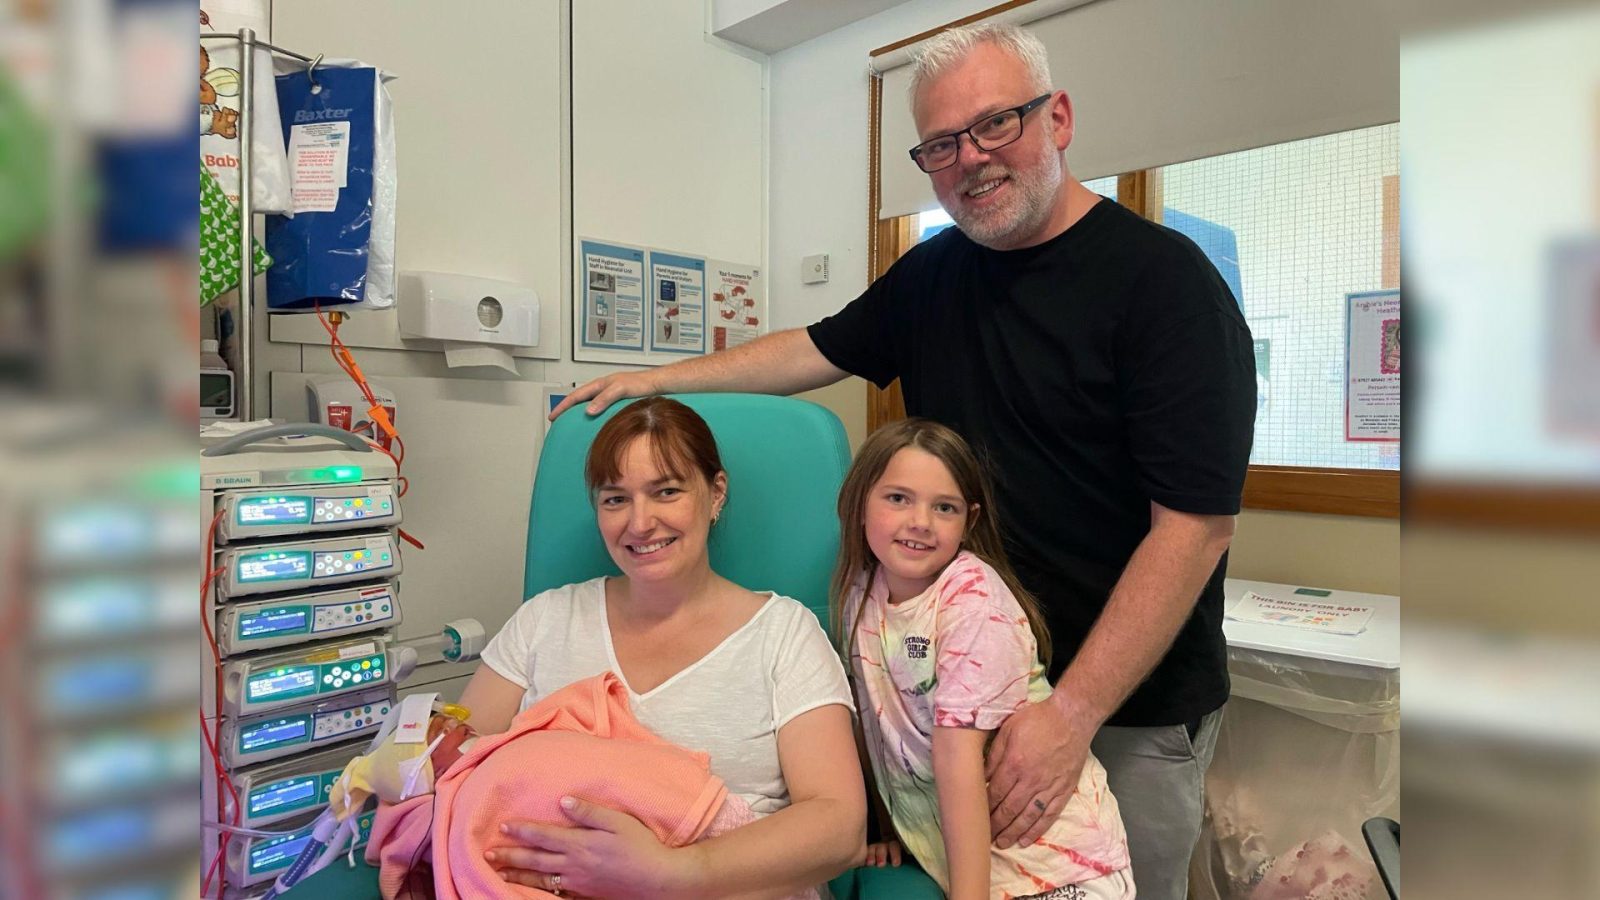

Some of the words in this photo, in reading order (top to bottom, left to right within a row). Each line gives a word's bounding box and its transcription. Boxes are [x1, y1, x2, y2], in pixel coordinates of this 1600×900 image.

[294, 108, 353, 122] Baxter
[601, 258, 618, 266] Hygiene
[667, 268, 682, 276] Hygiene
[1251, 594, 1274, 603] THIS
[1258, 603, 1312, 612] LAUNDRY
[904, 636, 931, 646] STRONG
